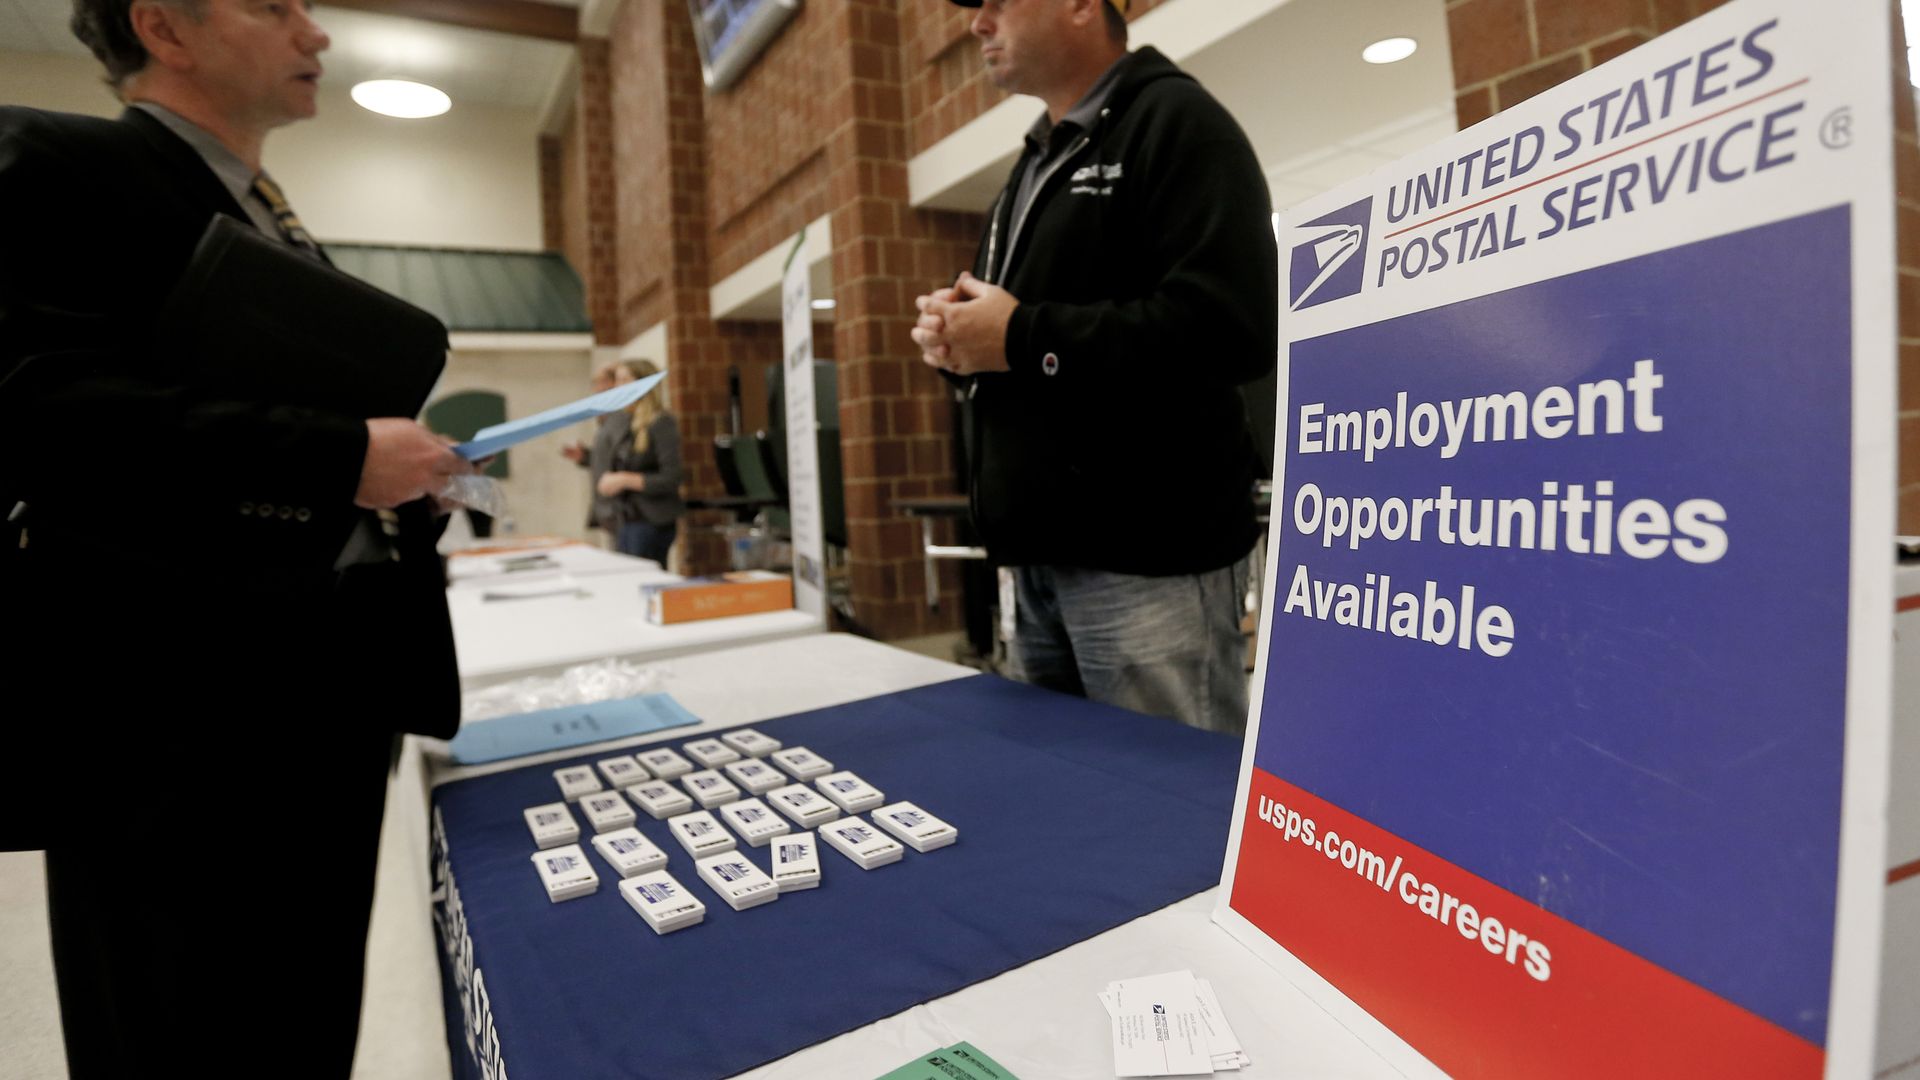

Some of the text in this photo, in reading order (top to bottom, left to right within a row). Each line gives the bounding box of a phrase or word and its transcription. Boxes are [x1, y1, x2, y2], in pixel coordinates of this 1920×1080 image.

[1385, 17, 1780, 224] UNITED STATES
[1377, 204, 1526, 288] POSTAL
[1537, 101, 1805, 241] SERVICE
[1297, 358, 1665, 462] Employment
[1293, 480, 1729, 564] Opportunities
[1283, 563, 1516, 658] Available
[1257, 794, 1552, 982] usps.com/careers
